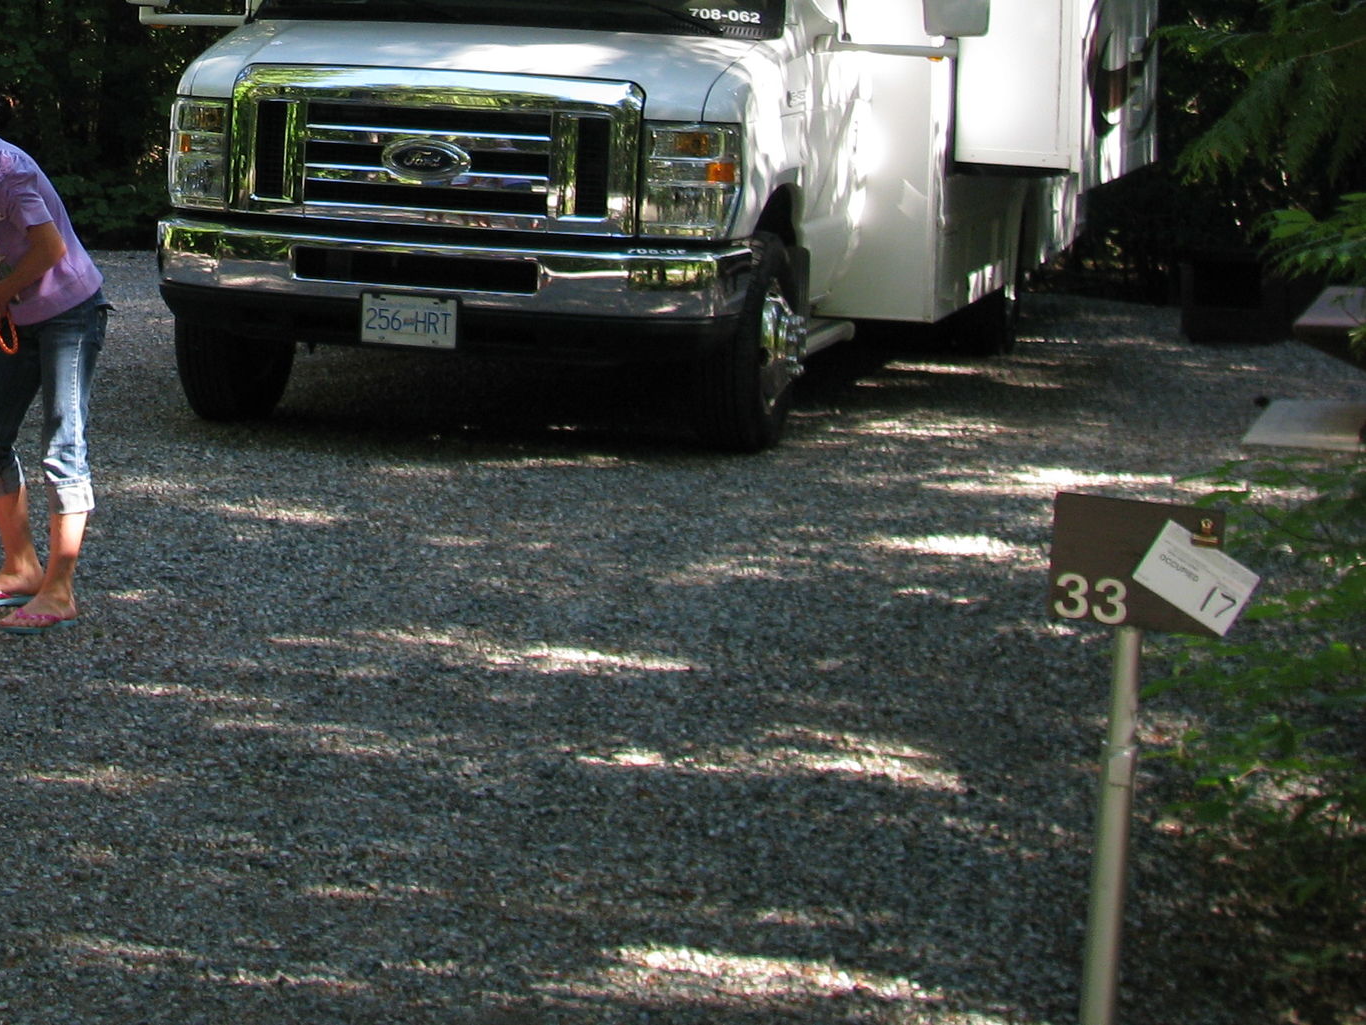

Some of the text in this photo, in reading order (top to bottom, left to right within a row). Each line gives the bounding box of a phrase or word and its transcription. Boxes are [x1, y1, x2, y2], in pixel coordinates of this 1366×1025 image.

[688, 7, 762, 25] 708-062
[1053, 572, 1128, 625] 33
[1199, 585, 1238, 619] 17
